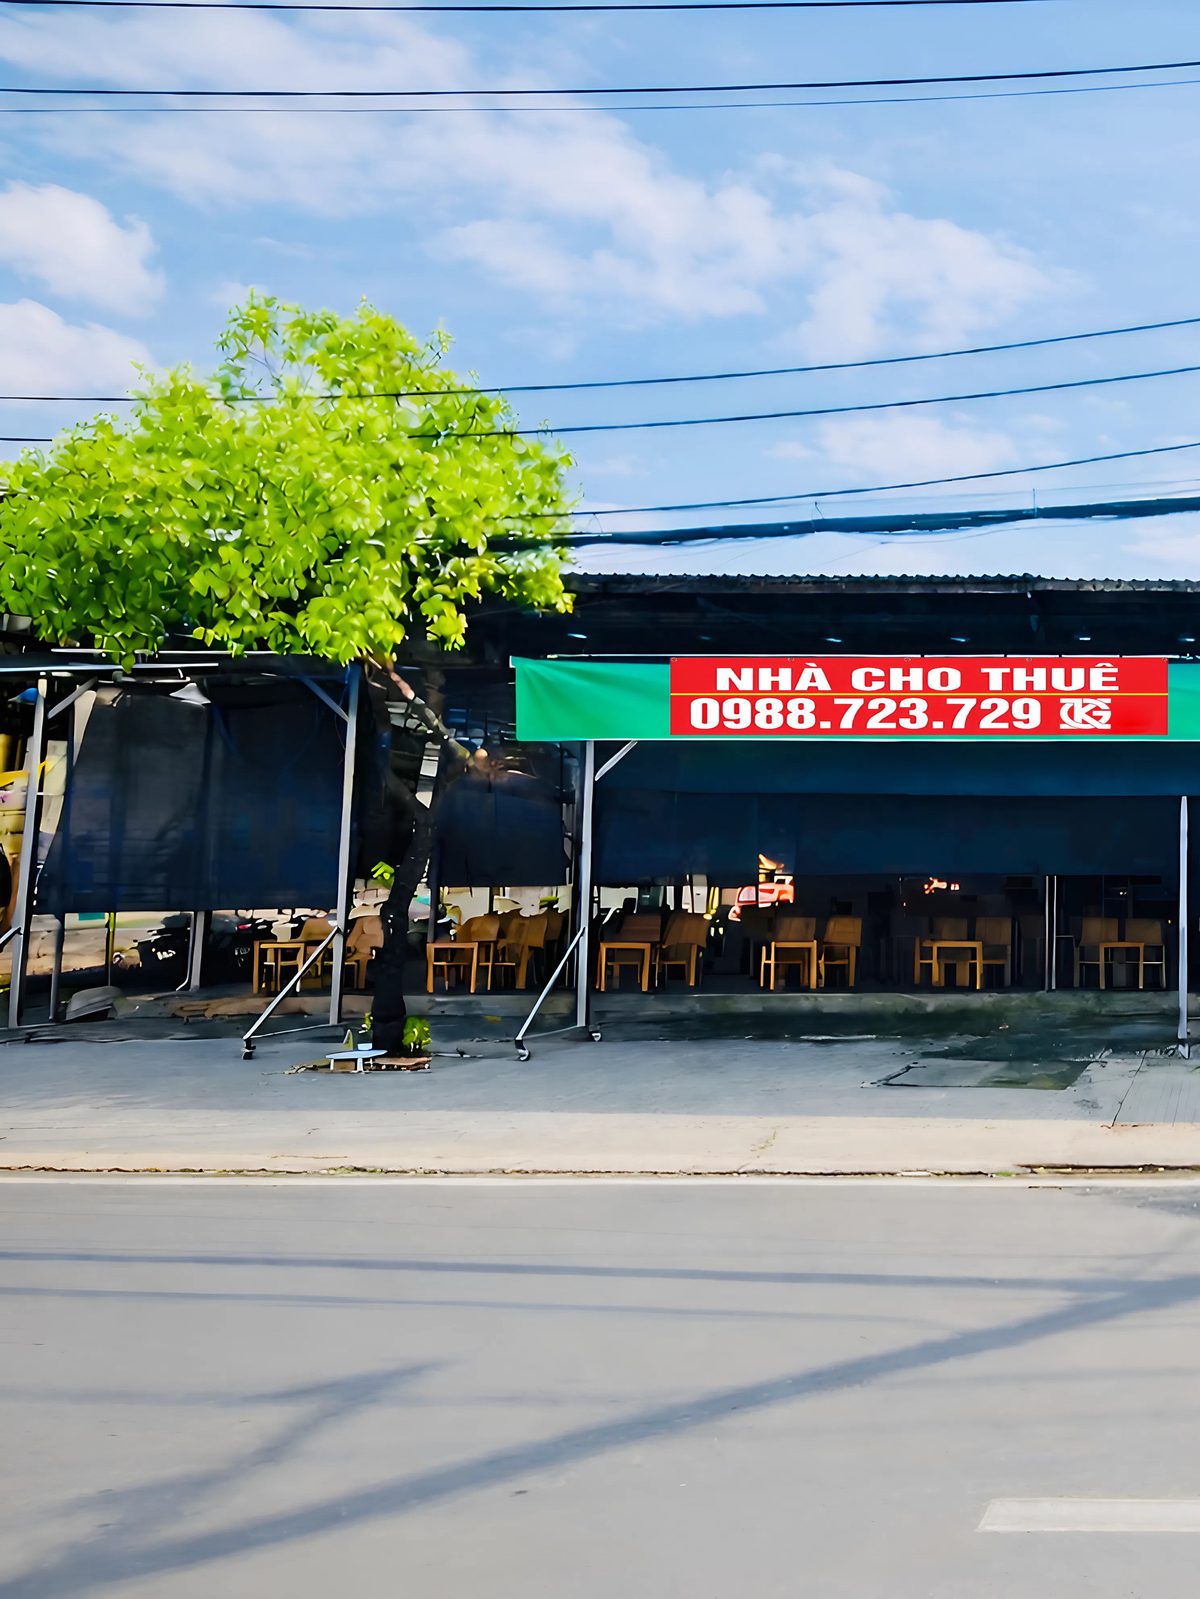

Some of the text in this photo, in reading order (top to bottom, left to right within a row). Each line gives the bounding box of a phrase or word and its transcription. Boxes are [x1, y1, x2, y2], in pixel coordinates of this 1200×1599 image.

[716, 662, 1119, 692] NHÀ CHO THUÊ
[690, 697, 1041, 730] 0988.723.729
